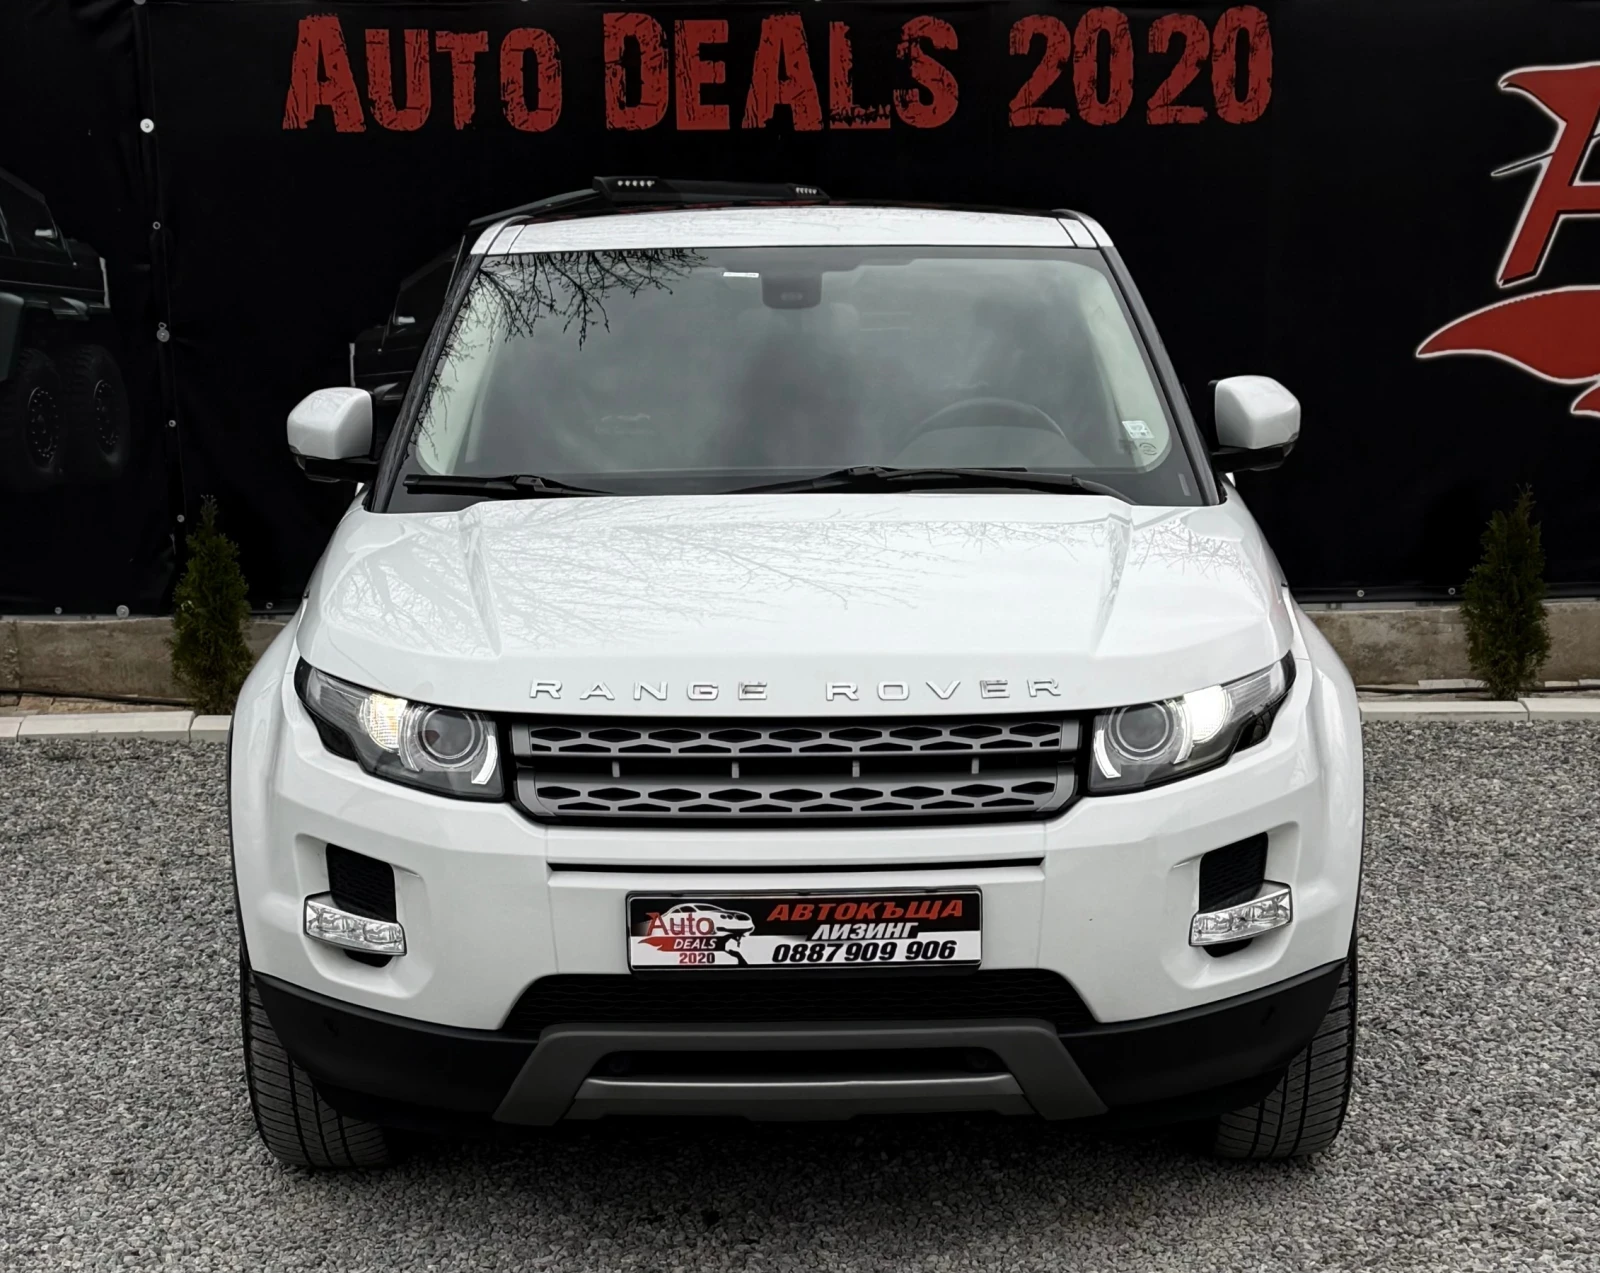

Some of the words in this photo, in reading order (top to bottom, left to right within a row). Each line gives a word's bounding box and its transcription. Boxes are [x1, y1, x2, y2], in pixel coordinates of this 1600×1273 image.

[283, 16, 561, 132] AUTO
[603, 13, 957, 131] DEALS
[1010, 7, 1272, 126] 2020
[529, 678, 769, 701] RANGE
[825, 678, 1063, 702] ROVER
[766, 899, 964, 922] АВТОКЪЩА
[645, 911, 715, 937] Auto
[811, 922, 919, 941] ЛИЗИНГ
[673, 938, 718, 950] DEALS
[772, 942, 844, 963] 0887
[844, 942, 898, 962] 909
[905, 940, 957, 960] 906
[679, 952, 716, 965] 2020
